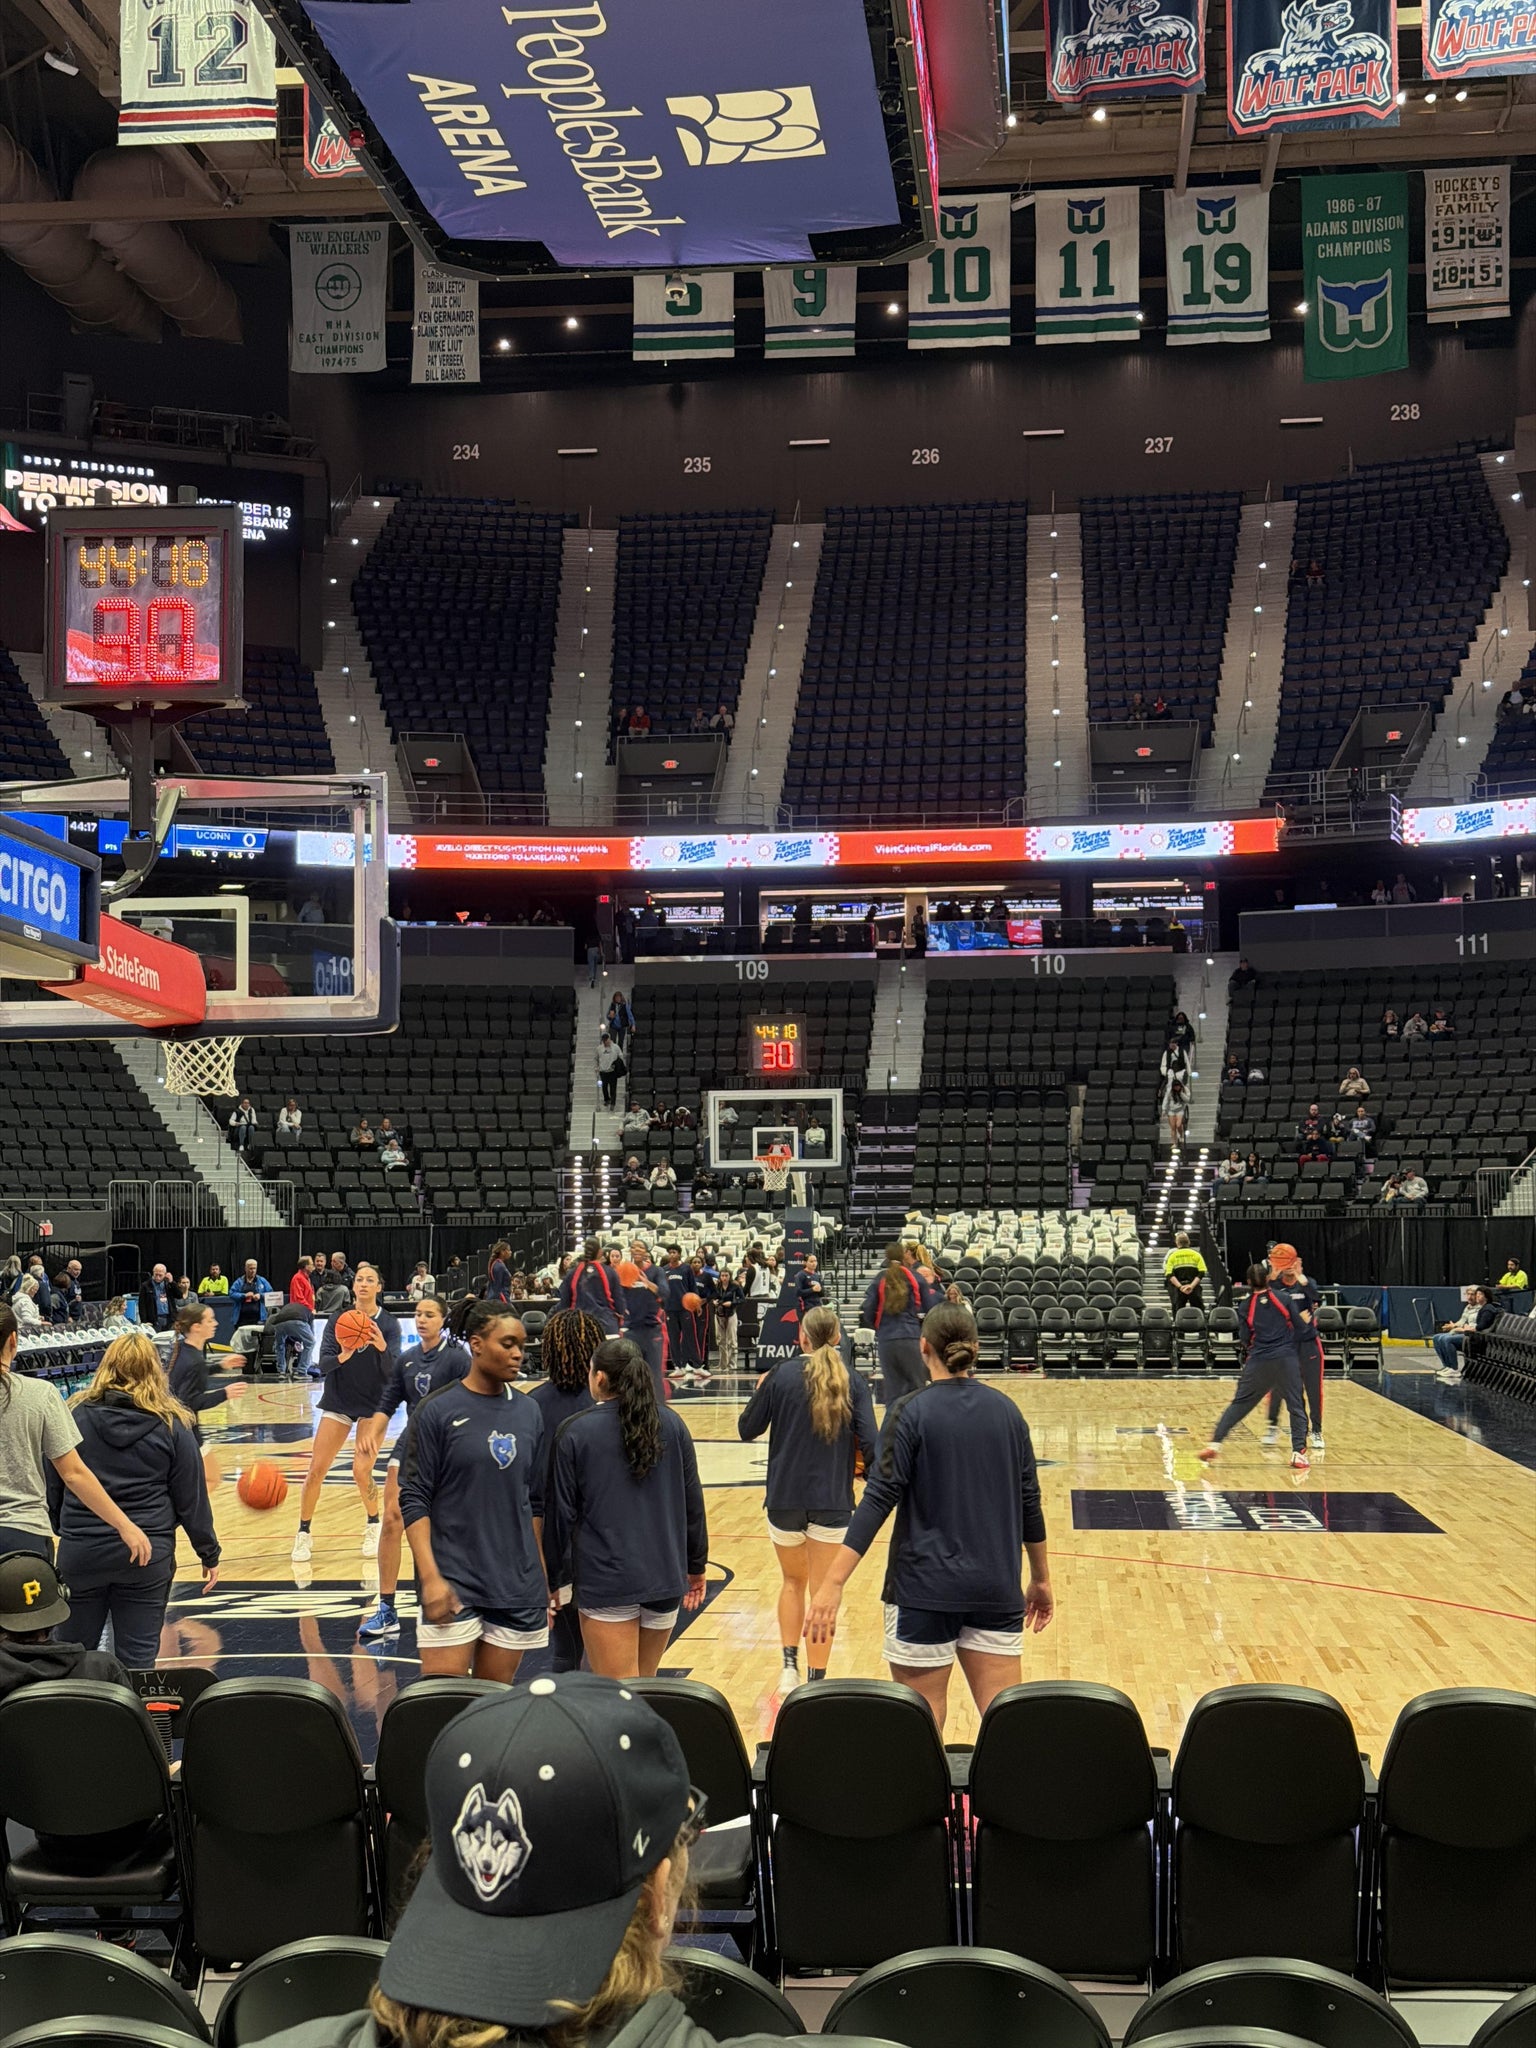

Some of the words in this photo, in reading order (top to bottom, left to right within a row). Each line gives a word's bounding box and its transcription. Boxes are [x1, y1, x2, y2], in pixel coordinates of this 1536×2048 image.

[1435, 15, 1507, 59] WOLF
[148, 11, 248, 88] 12
[1057, 51, 1118, 87] WOLF
[1119, 38, 1190, 74] PACK
[1280, 57, 1362, 78] HARTFORD
[1240, 70, 1310, 114] WOLF
[1313, 59, 1385, 100] PACK
[500, 0, 686, 239] PeoplesBank
[407, 73, 528, 197] ARENA
[1434, 176, 1500, 194] HOCKEY'S
[1326, 199, 1356, 214] 1986
[1366, 195, 1382, 211] 87
[1442, 191, 1493, 203] FIRST
[1435, 201, 1500, 217] FAMILY
[1305, 220, 1348, 237] ADAMS
[1352, 214, 1405, 235] DIVISION
[296, 231, 323, 243] NEW
[327, 230, 382, 243] ENGLAND
[1443, 226, 1455, 244] 9
[310, 243, 370, 255] WHALERS
[1317, 238, 1392, 259] CHAMPIONS
[927, 246, 991, 304] 10
[1058, 239, 1115, 298] 11
[1183, 242, 1252, 306] 19
[1440, 266, 1459, 284] 18
[1479, 264, 1491, 282] 5
[427, 281, 444, 294] BRIAN
[445, 280, 466, 293] LEETCH
[793, 269, 827, 317] 9
[430, 296, 448, 308] JULIE
[418, 311, 432, 323] KEN
[433, 311, 475, 323] GERNANDER
[298, 333, 325, 344] EAST
[333, 331, 380, 343] DIVISION
[417, 326, 439, 338] BLAINE
[439, 325, 476, 337] STOUGHTON
[314, 345, 364, 355] CHAMPIONS
[429, 340, 446, 352] MIKE
[447, 340, 463, 352] LIUT
[427, 354, 438, 366] PAT
[425, 369, 439, 381] BILL
[440, 368, 466, 381] BARNES
[1390, 402, 1420, 421] 238
[453, 444, 480, 460] 234
[1144, 436, 1173, 454] 237
[683, 456, 712, 473] 235
[912, 448, 941, 465] 236
[4, 469, 168, 505] PERMISSION
[276, 505, 292, 518] 13
[80, 540, 209, 588] 44:18
[1454, 814, 1492, 833] FLORIDA
[1456, 807, 1495, 824] CENTRAL
[69, 821, 98, 832] 44:17
[1169, 827, 1207, 841] CENTRAL
[196, 831, 231, 841] UCONN
[242, 832, 256, 848] 0
[776, 839, 813, 852] CENTRAL
[1071, 837, 1110, 852] FLORIDA
[1074, 830, 1112, 844] CENTRAL
[1166, 834, 1205, 850] FLORIDA
[678, 846, 715, 862] FLORIDA
[680, 840, 717, 853] CENTRAL
[773, 845, 811, 861] FLORIDA
[0, 852, 67, 922] CITGO
[1455, 932, 1489, 955] 111
[328, 956, 354, 977] 10
[735, 961, 769, 981] 109
[1030, 955, 1066, 975] 110
[756, 1023, 798, 1039] 44:18
[763, 1041, 794, 1069] 30
[22, 1579, 41, 1605] P
[139, 1685, 182, 1697] CREW
